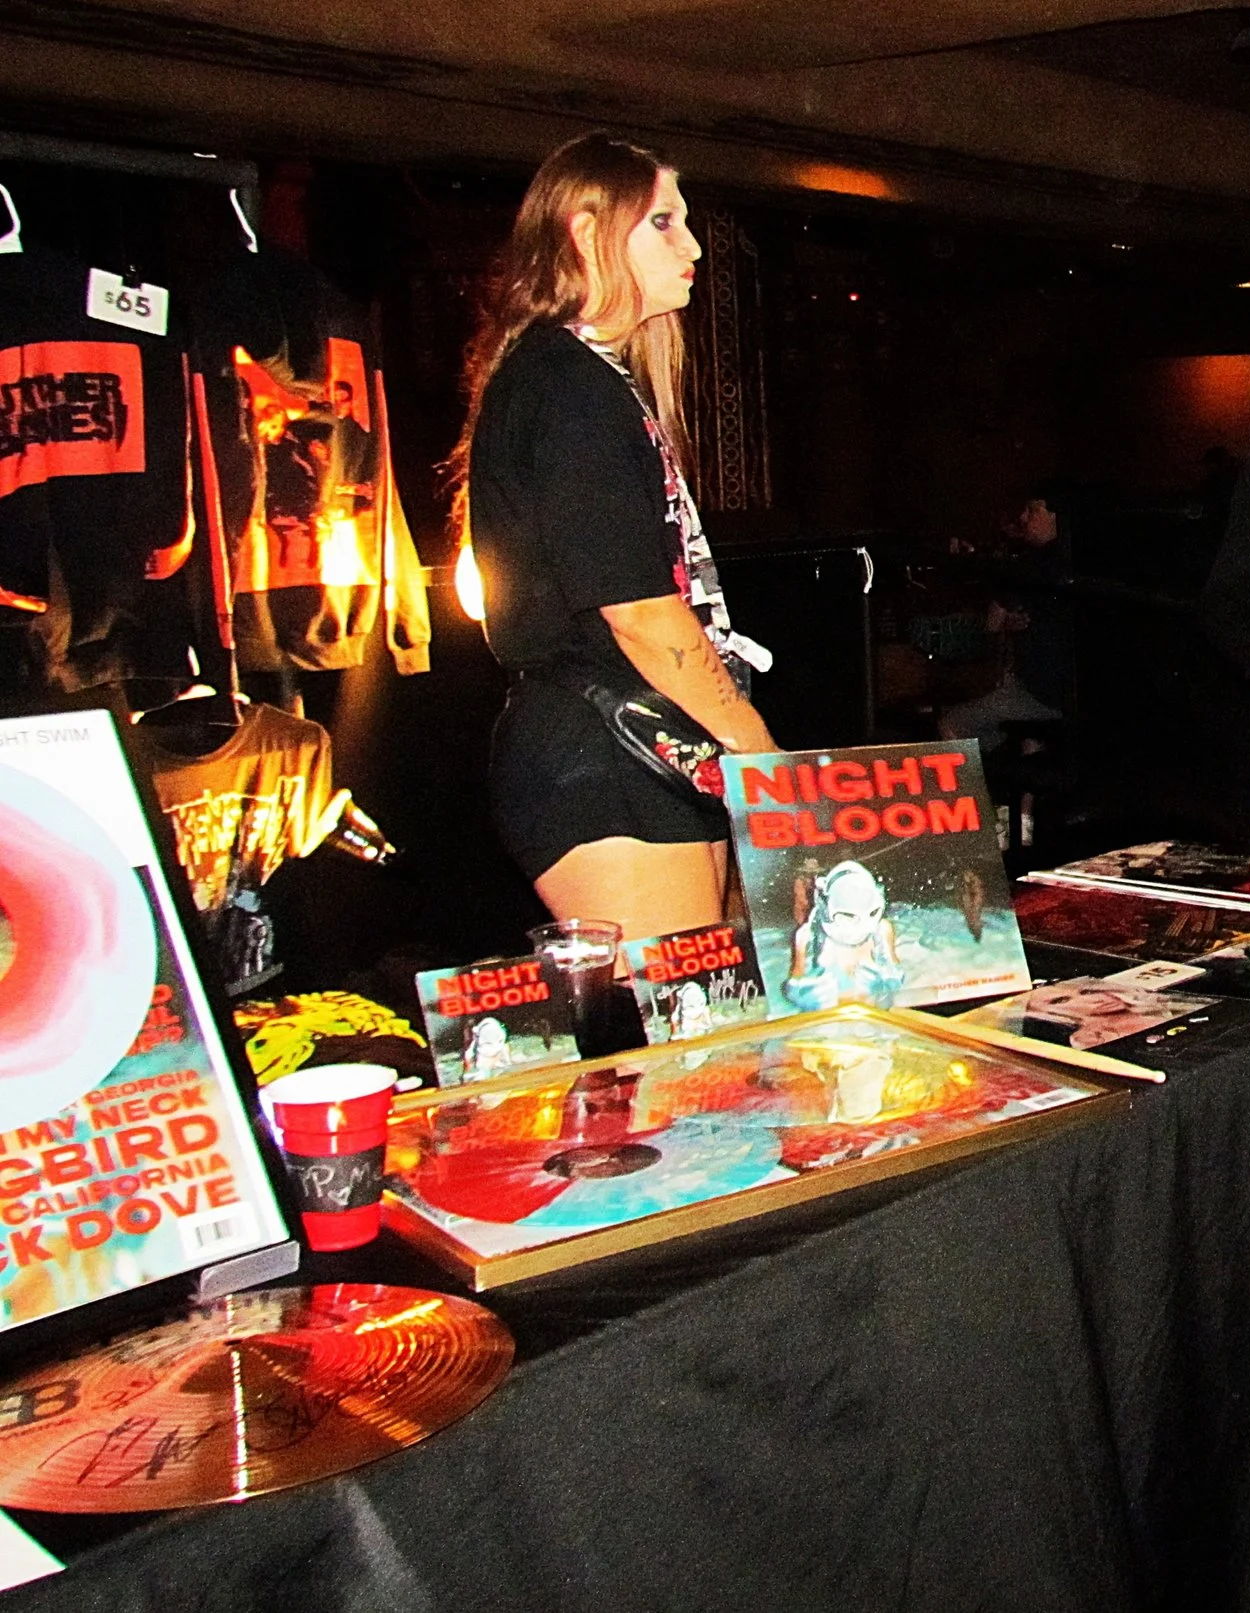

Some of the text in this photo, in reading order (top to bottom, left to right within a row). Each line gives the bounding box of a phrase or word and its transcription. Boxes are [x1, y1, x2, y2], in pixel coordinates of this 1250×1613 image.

[36, 728, 90, 744] SWIM
[740, 753, 967, 805] NIGHT
[746, 796, 982, 850] BLOOM
[641, 927, 735, 962] NIGHT
[645, 946, 744, 984] BLOOM
[435, 961, 543, 997] NIGHT
[438, 981, 550, 1018] BLOOM
[15, 1114, 76, 1150] MY
[90, 1083, 208, 1131] NECK
[0, 1113, 220, 1200] GBIRD
[2, 1152, 231, 1226] CALIFORNIA
[0, 1174, 241, 1273] K DOVE
